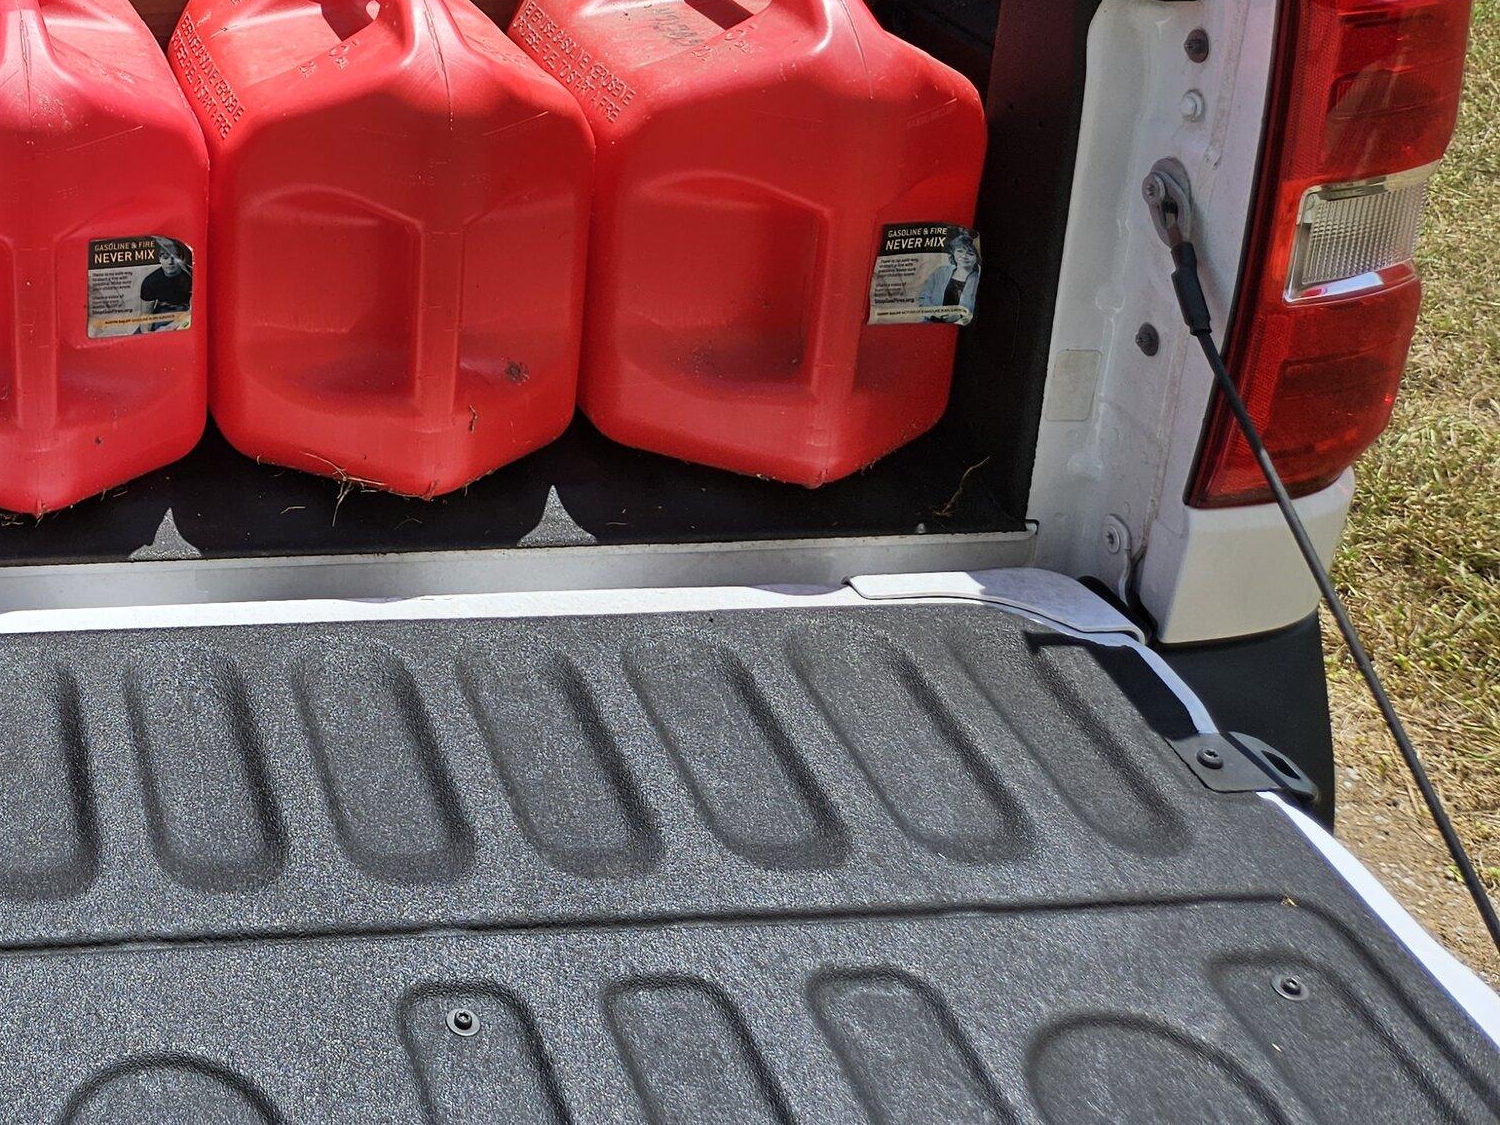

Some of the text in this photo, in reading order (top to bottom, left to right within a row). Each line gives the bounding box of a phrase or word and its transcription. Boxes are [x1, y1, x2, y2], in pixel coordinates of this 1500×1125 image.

[888, 228, 922, 238] GASOLINE
[930, 227, 948, 235] FIRE
[94, 242, 129, 251] GASOLINE
[886, 237, 946, 250] NEVER MIX
[94, 249, 155, 263] NEVER MIX
